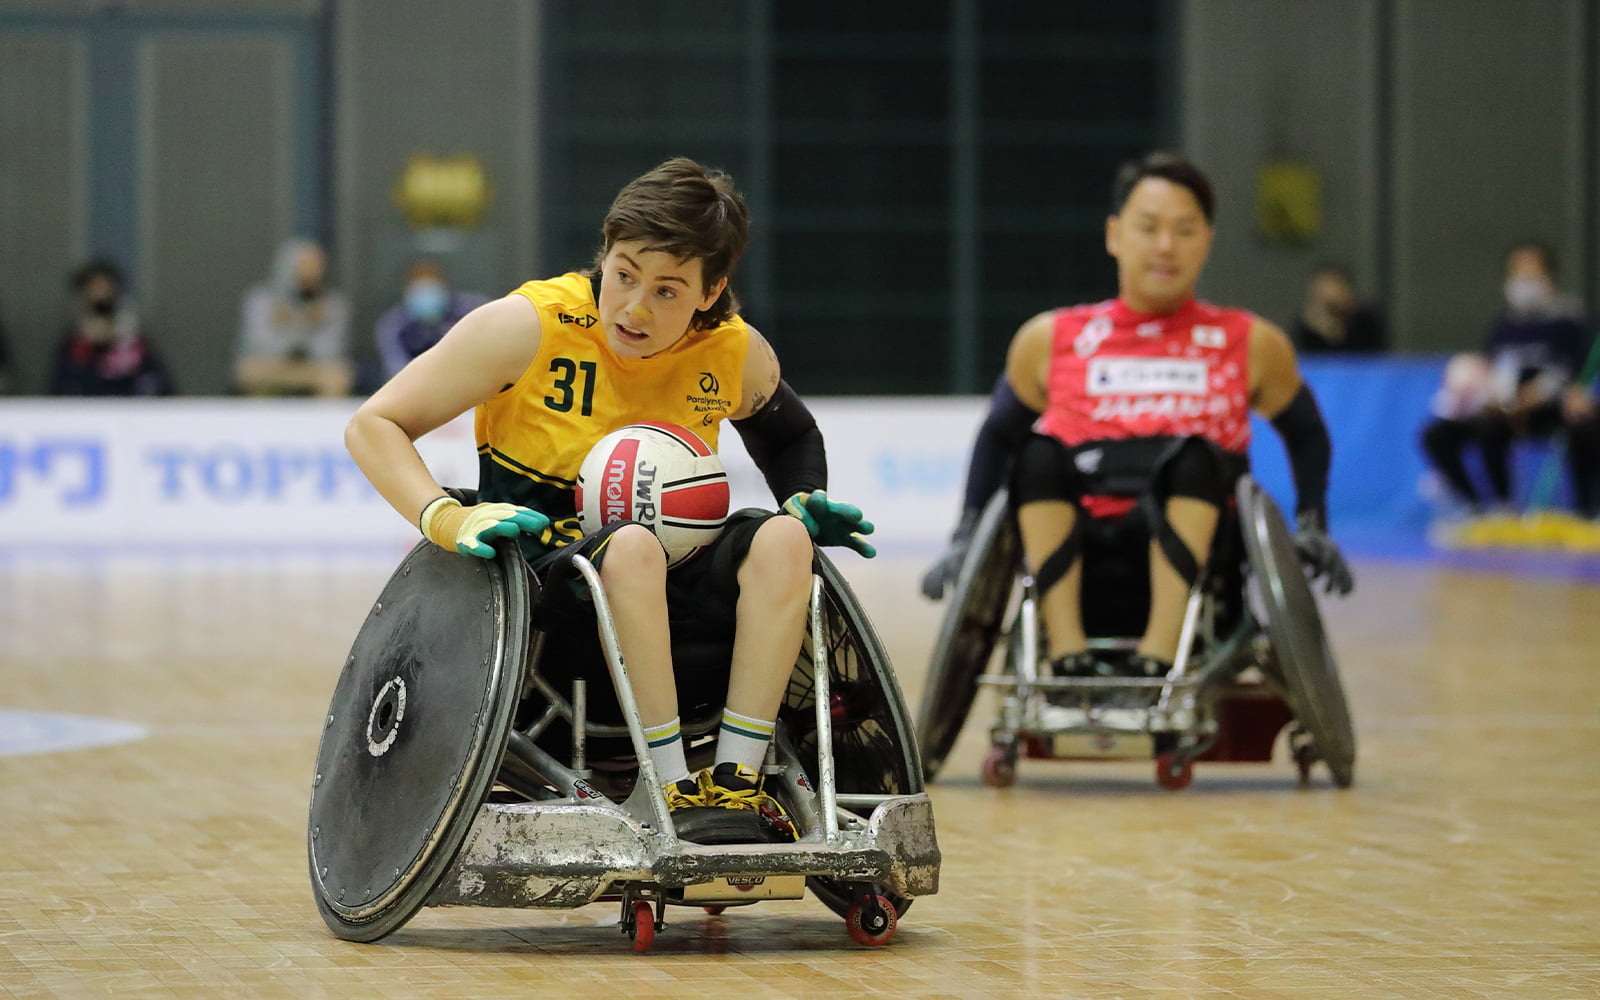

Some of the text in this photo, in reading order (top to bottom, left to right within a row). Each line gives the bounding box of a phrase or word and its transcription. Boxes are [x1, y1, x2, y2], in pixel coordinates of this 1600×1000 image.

[543, 357, 597, 417] 31
[147, 444, 374, 500] TOPP
[635, 460, 657, 536] JWR
[727, 876, 764, 884] VESCO
